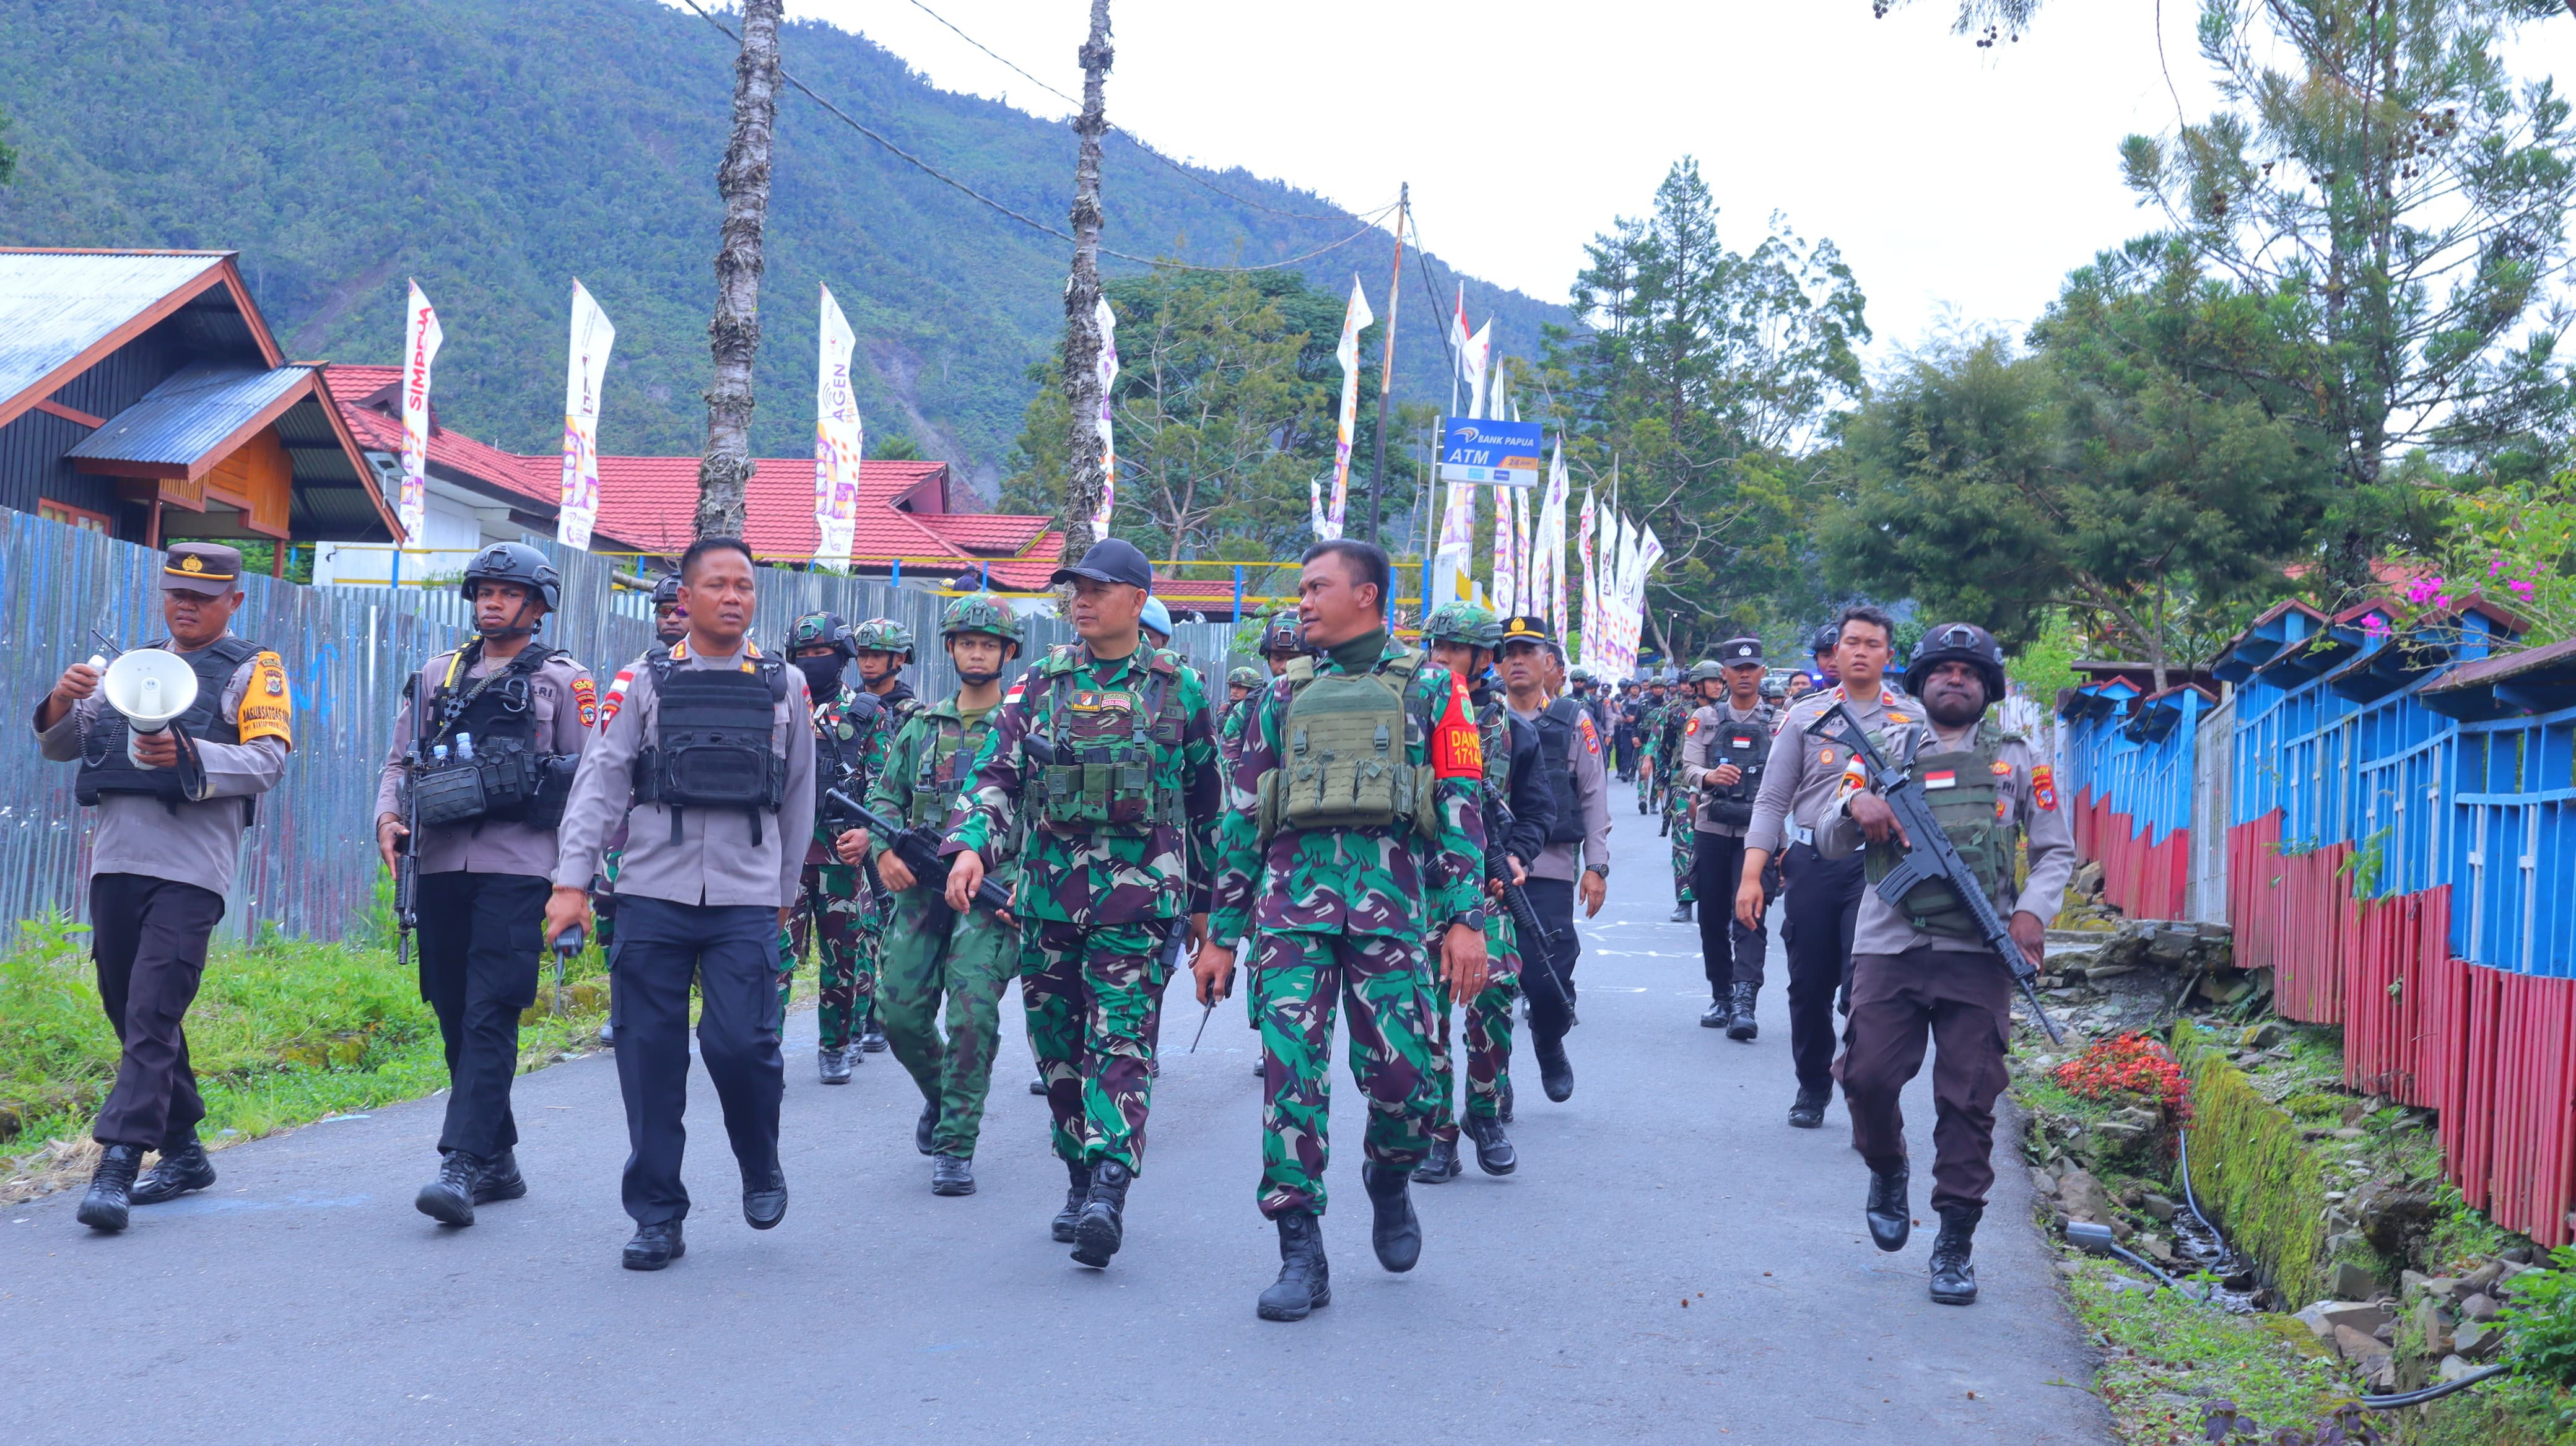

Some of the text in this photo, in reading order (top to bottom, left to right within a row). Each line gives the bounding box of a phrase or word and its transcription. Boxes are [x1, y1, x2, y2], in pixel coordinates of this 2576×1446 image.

[832, 364, 846, 422] AGEN
[1477, 434, 1534, 447] BANK PAPUA
[1448, 448, 1490, 465] ATM
[1508, 458, 1520, 466] 24
